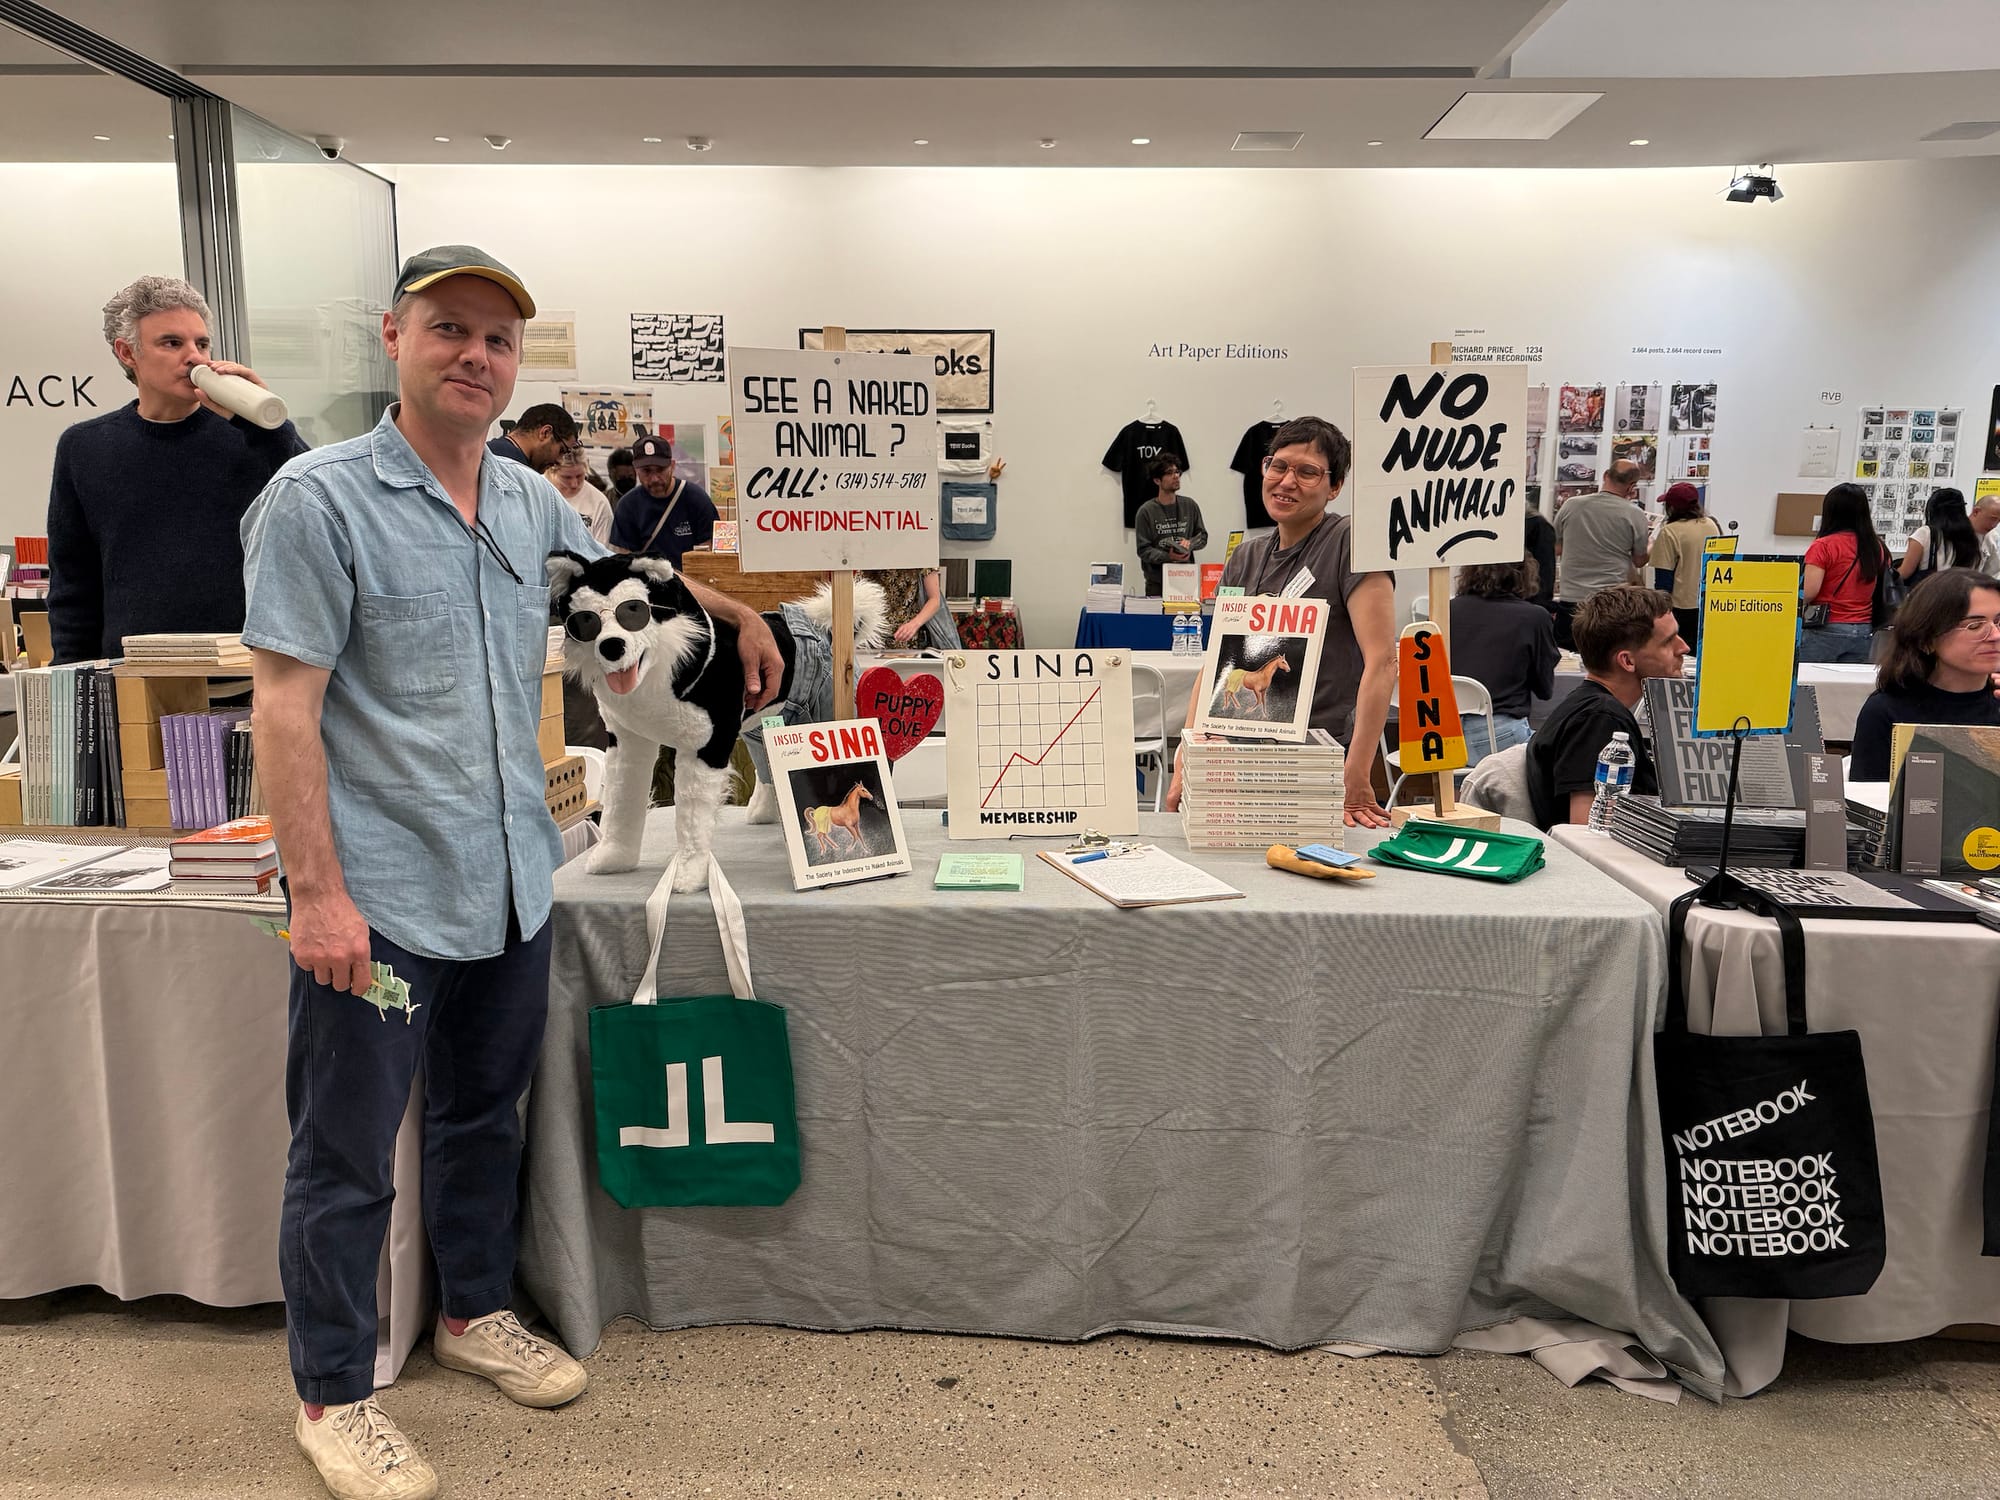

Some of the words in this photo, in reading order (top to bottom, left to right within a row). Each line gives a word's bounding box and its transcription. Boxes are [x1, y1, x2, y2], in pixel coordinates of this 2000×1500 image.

[1149, 343, 1173, 357] Art
[1178, 343, 1222, 361] Paper
[1226, 344, 1288, 359] Editions
[6, 375, 98, 407] ACK
[743, 376, 798, 413] SEE
[814, 378, 832, 414] A
[848, 380, 929, 416] NAKED
[1380, 372, 1488, 423] NO
[1822, 392, 1841, 400] RVB
[775, 421, 876, 457] ANIMAL
[890, 423, 906, 457] ?
[1382, 423, 1507, 473] NUDE
[746, 466, 828, 499] CALL:
[835, 472, 868, 490] (314)
[870, 473, 927, 489] 514-5181
[756, 510, 928, 531] CONFIDNENTIAL
[1389, 477, 1515, 560] ANIMALS
[1712, 567, 1733, 584] A4
[1222, 602, 1248, 612] INSIDE
[1249, 604, 1318, 634] SINA
[1710, 599, 1736, 612] Mubi
[1740, 600, 1783, 612] Editions
[987, 653, 1094, 680] SINA
[874, 692, 934, 717] PUPPY
[1413, 630, 1444, 762] SINA
[879, 717, 922, 737] LOVE
[773, 733, 804, 747] INSIDE
[809, 726, 880, 762] SINA
[1677, 741, 1736, 770] TYPE
[1683, 772, 1742, 802] FILM
[980, 811, 1077, 824] MEMBERSHIP
[1672, 1079, 1817, 1155] NOTEBOOK
[1680, 1152, 1837, 1184] NOTEBOOK
[1682, 1176, 1840, 1208] NOTEBOOK
[1684, 1200, 1844, 1232] NOTEBOOK
[1687, 1224, 1849, 1256] NOTEBOOK
